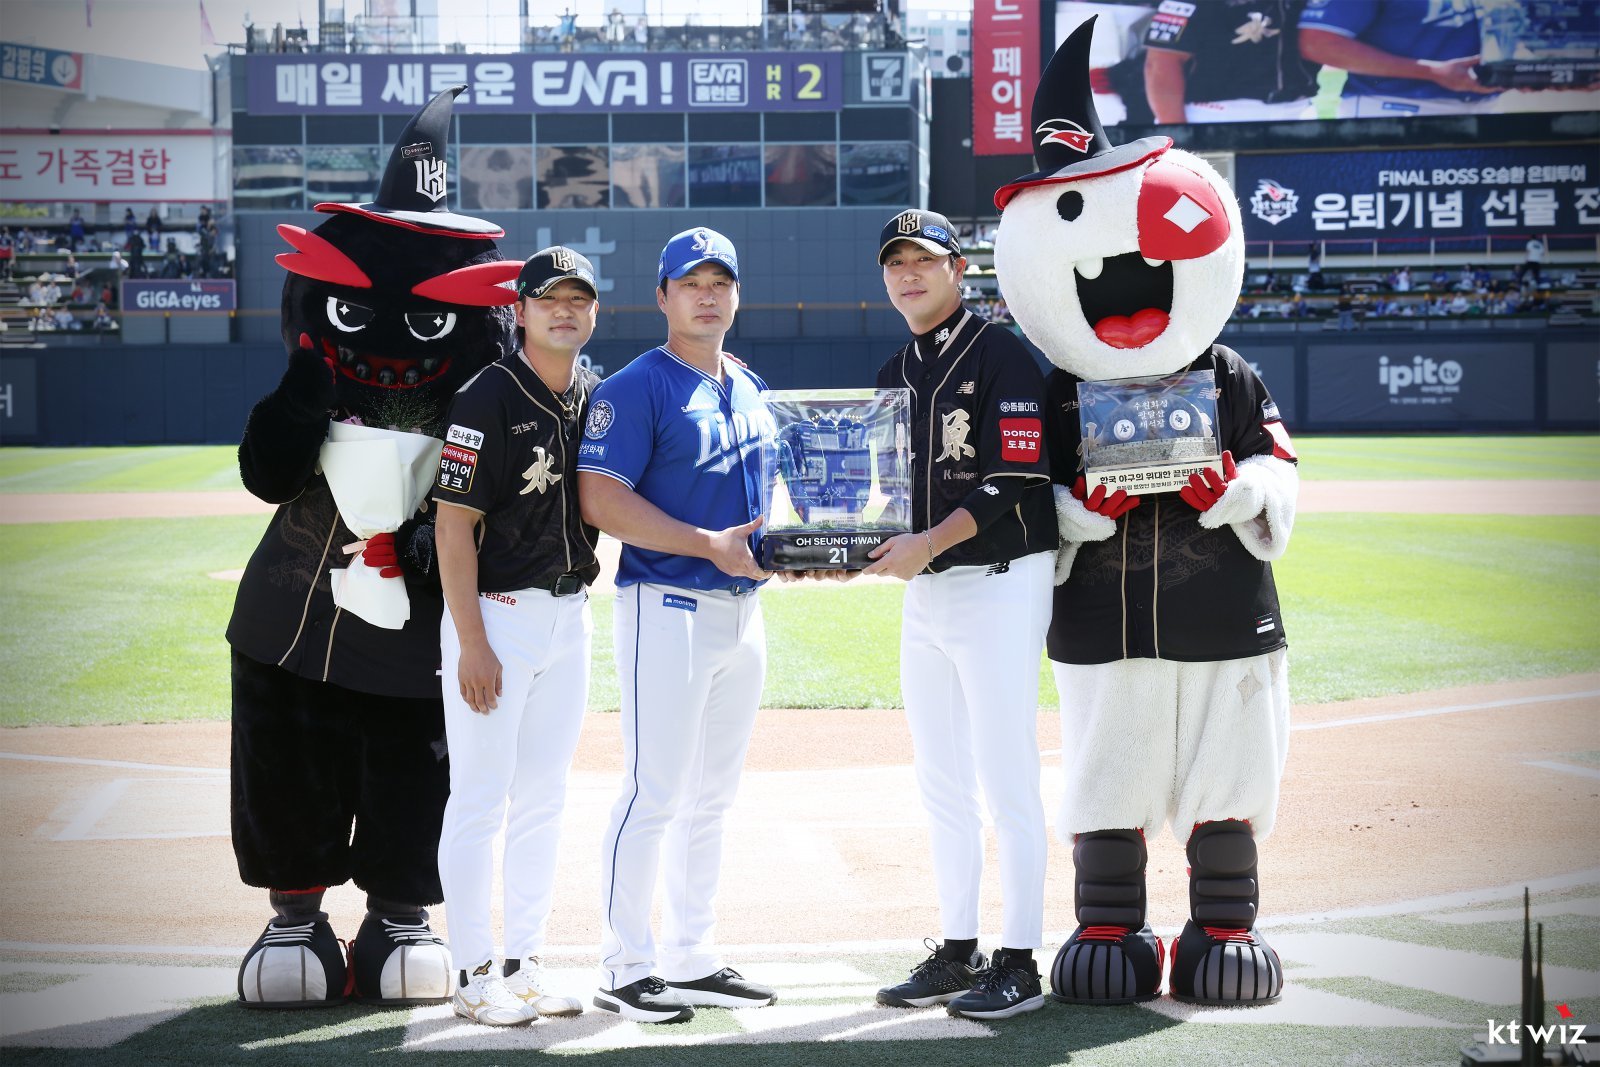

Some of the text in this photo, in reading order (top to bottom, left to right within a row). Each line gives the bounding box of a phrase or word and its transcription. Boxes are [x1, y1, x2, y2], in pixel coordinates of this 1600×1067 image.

[276, 62, 363, 106] 매일
[380, 62, 516, 106] 새로운
[797, 63, 822, 99] 2
[991, 46, 1024, 143] 페이북
[37, 147, 171, 186] 가족결합
[1378, 170, 1428, 187] FINAL
[1432, 168, 1479, 186] BOSS
[1311, 191, 1464, 231] 은퇴기념
[1481, 188, 1560, 227] 선물
[451, 428, 482, 447] 모나용평
[935, 408, 976, 463] 原
[1003, 430, 1040, 438] DORCO
[1007, 440, 1037, 450] 도루코
[440, 459, 472, 479] 타이어
[1118, 473, 1144, 483] 야구의
[1145, 470, 1171, 480] 위대한
[441, 472, 463, 489] 뱅크
[796, 536, 881, 546] OH SEUNG HWAN
[828, 547, 848, 564] 21
[485, 591, 517, 606] estate
